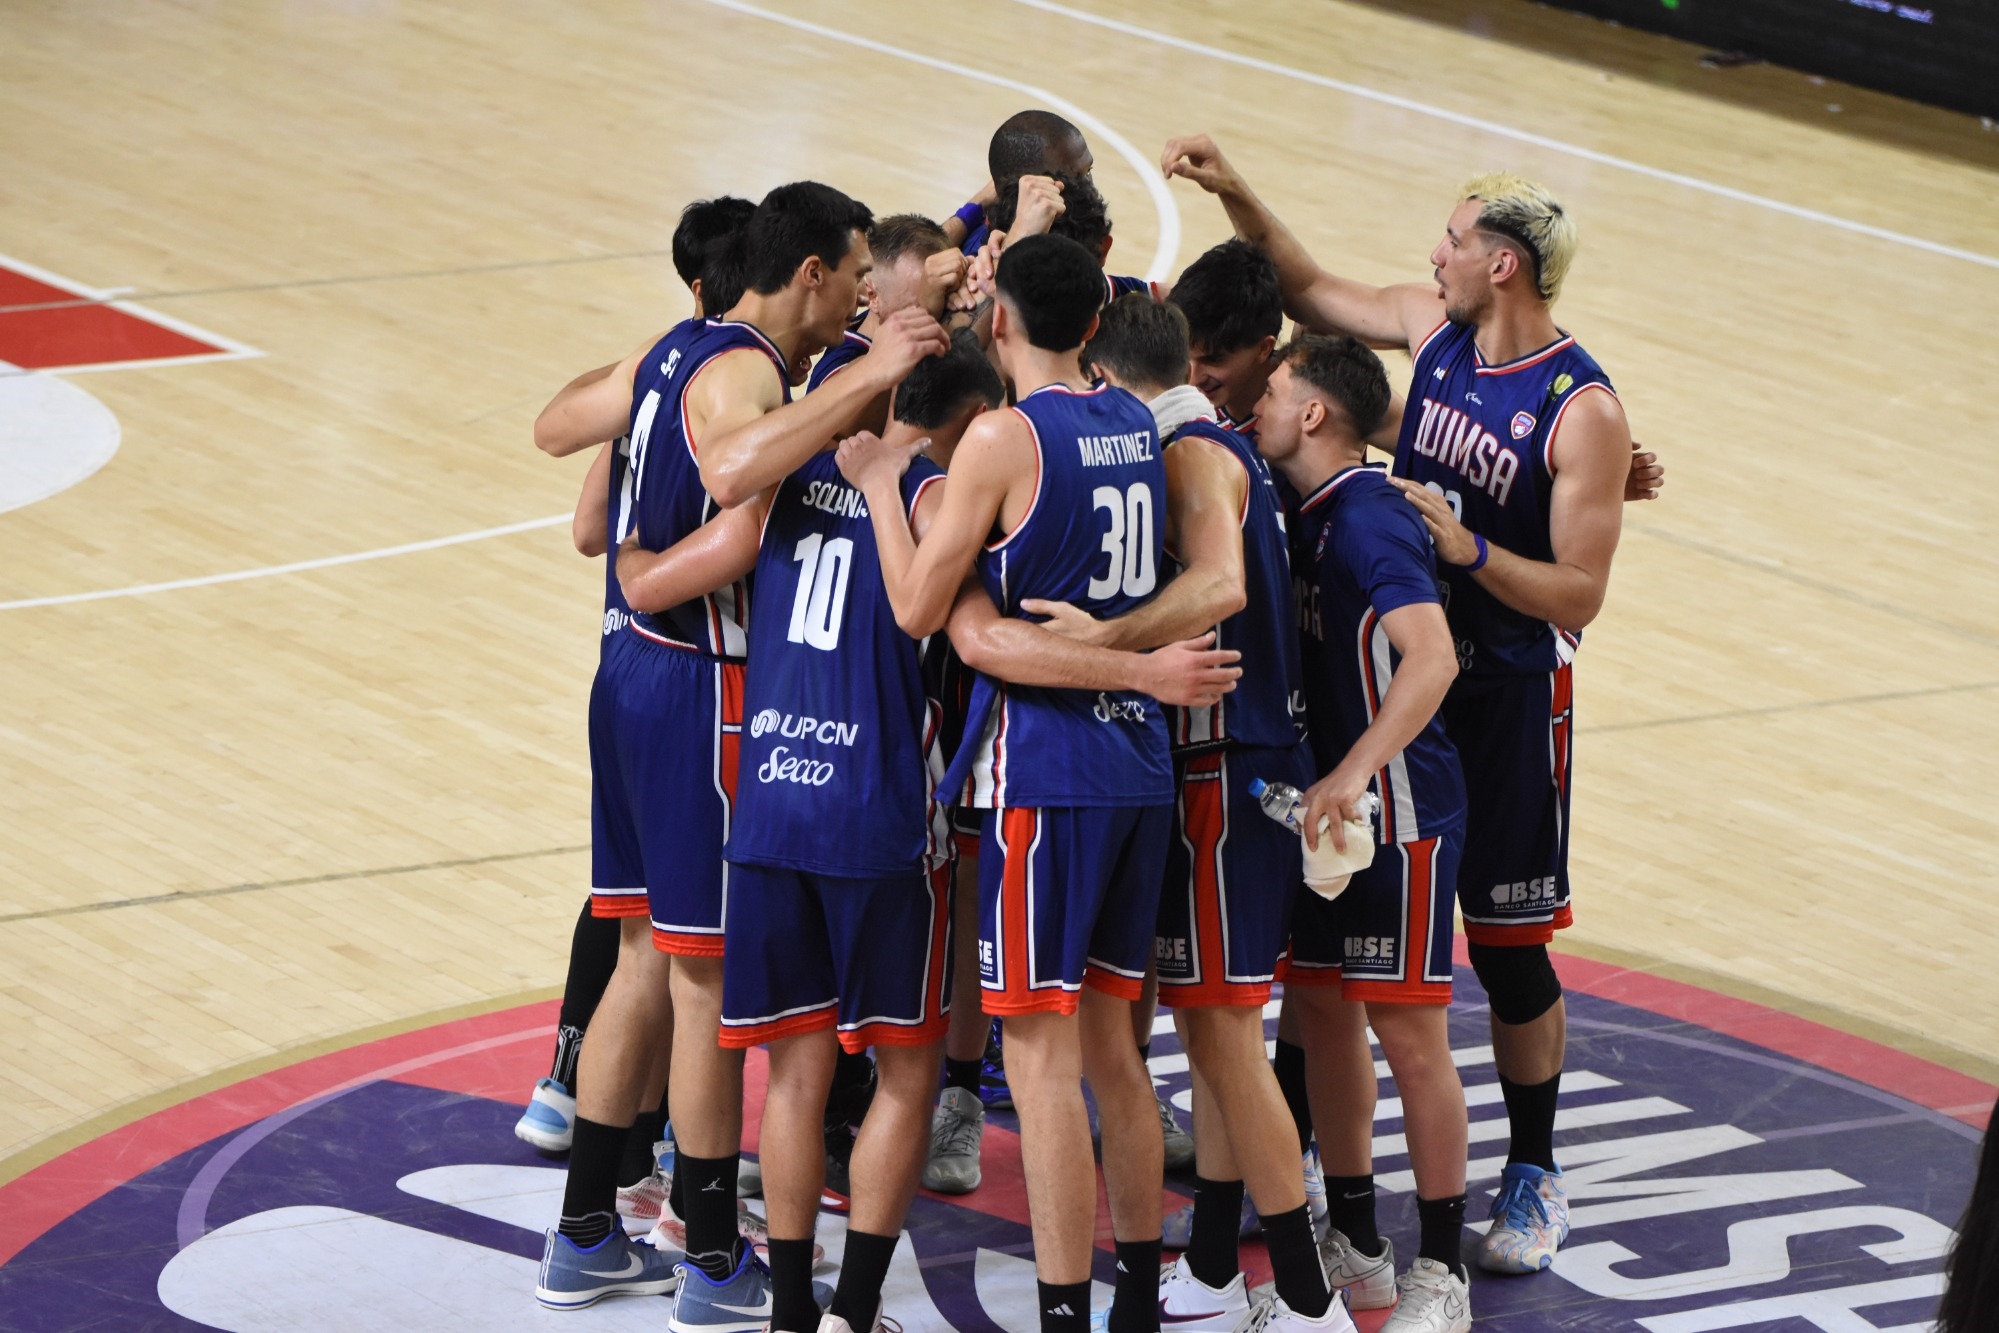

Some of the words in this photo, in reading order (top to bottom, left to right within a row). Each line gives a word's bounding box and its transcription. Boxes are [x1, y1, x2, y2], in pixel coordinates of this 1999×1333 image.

[1077, 431, 1154, 467] MARTINEZ
[802, 480, 869, 519] SOLAN
[1088, 482, 1156, 600] 30
[787, 533, 854, 651] 10
[780, 713, 859, 747] UPCN
[758, 746, 834, 786] Secco
[1511, 875, 1556, 903] BSE
